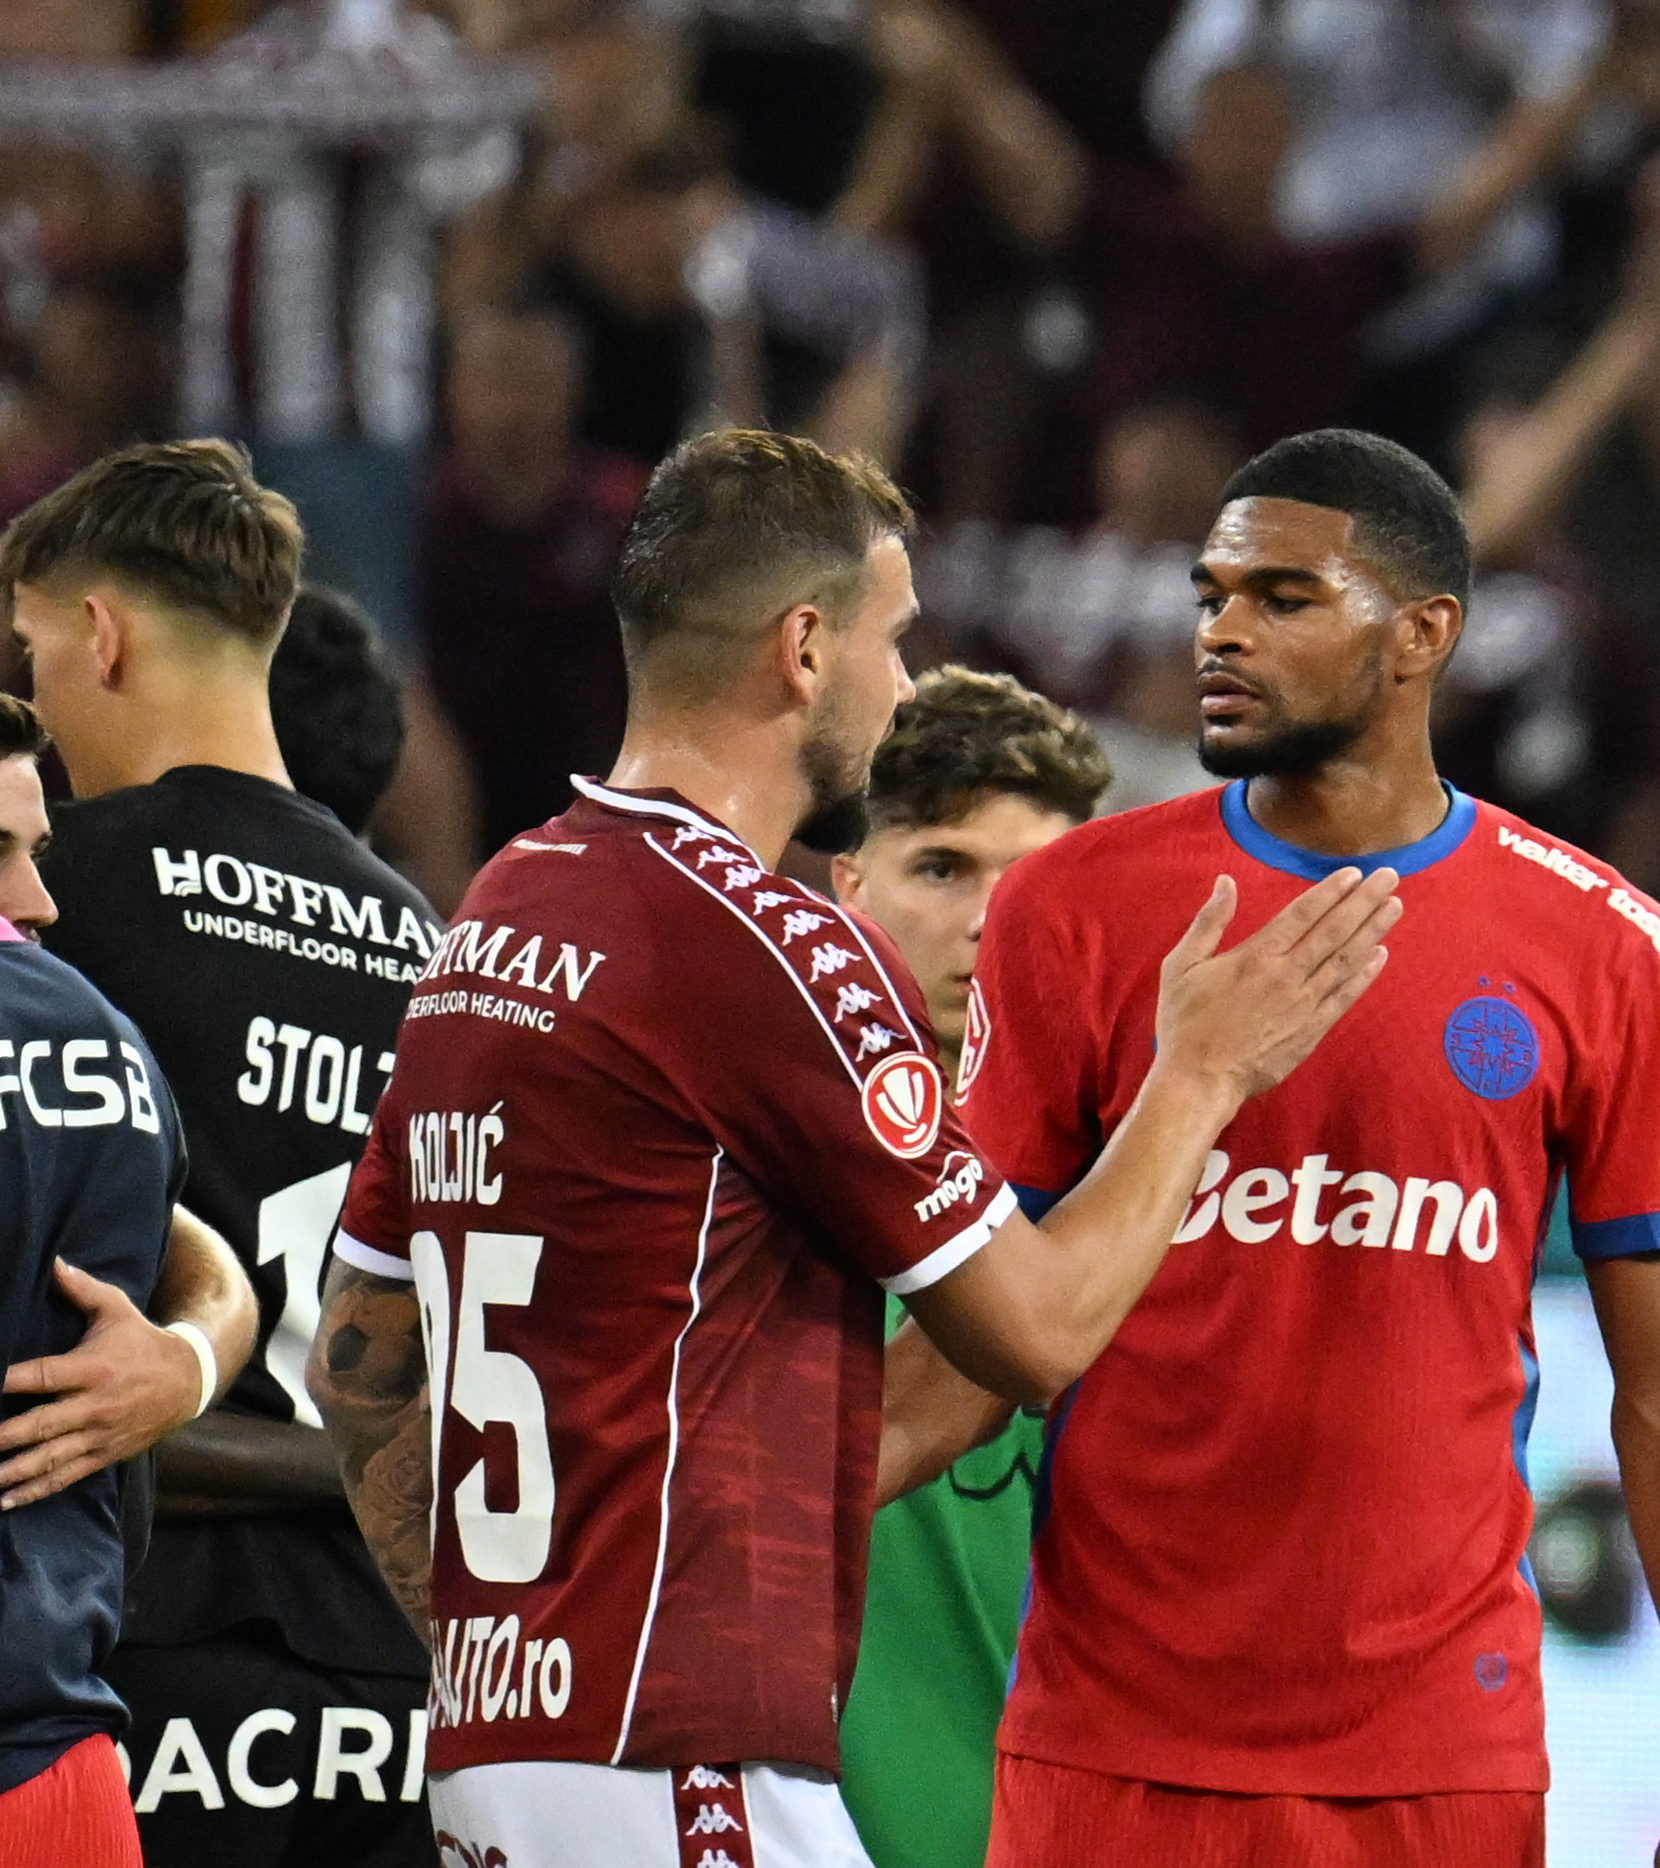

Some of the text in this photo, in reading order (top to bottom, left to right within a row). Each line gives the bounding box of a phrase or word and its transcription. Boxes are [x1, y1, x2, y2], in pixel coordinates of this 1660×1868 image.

[183, 908, 422, 985] UNDERFLOOR HEA
[469, 992, 556, 1034] HEATING
[913, 1156, 985, 1224] mogo
[114, 1706, 428, 1814] ACRI
